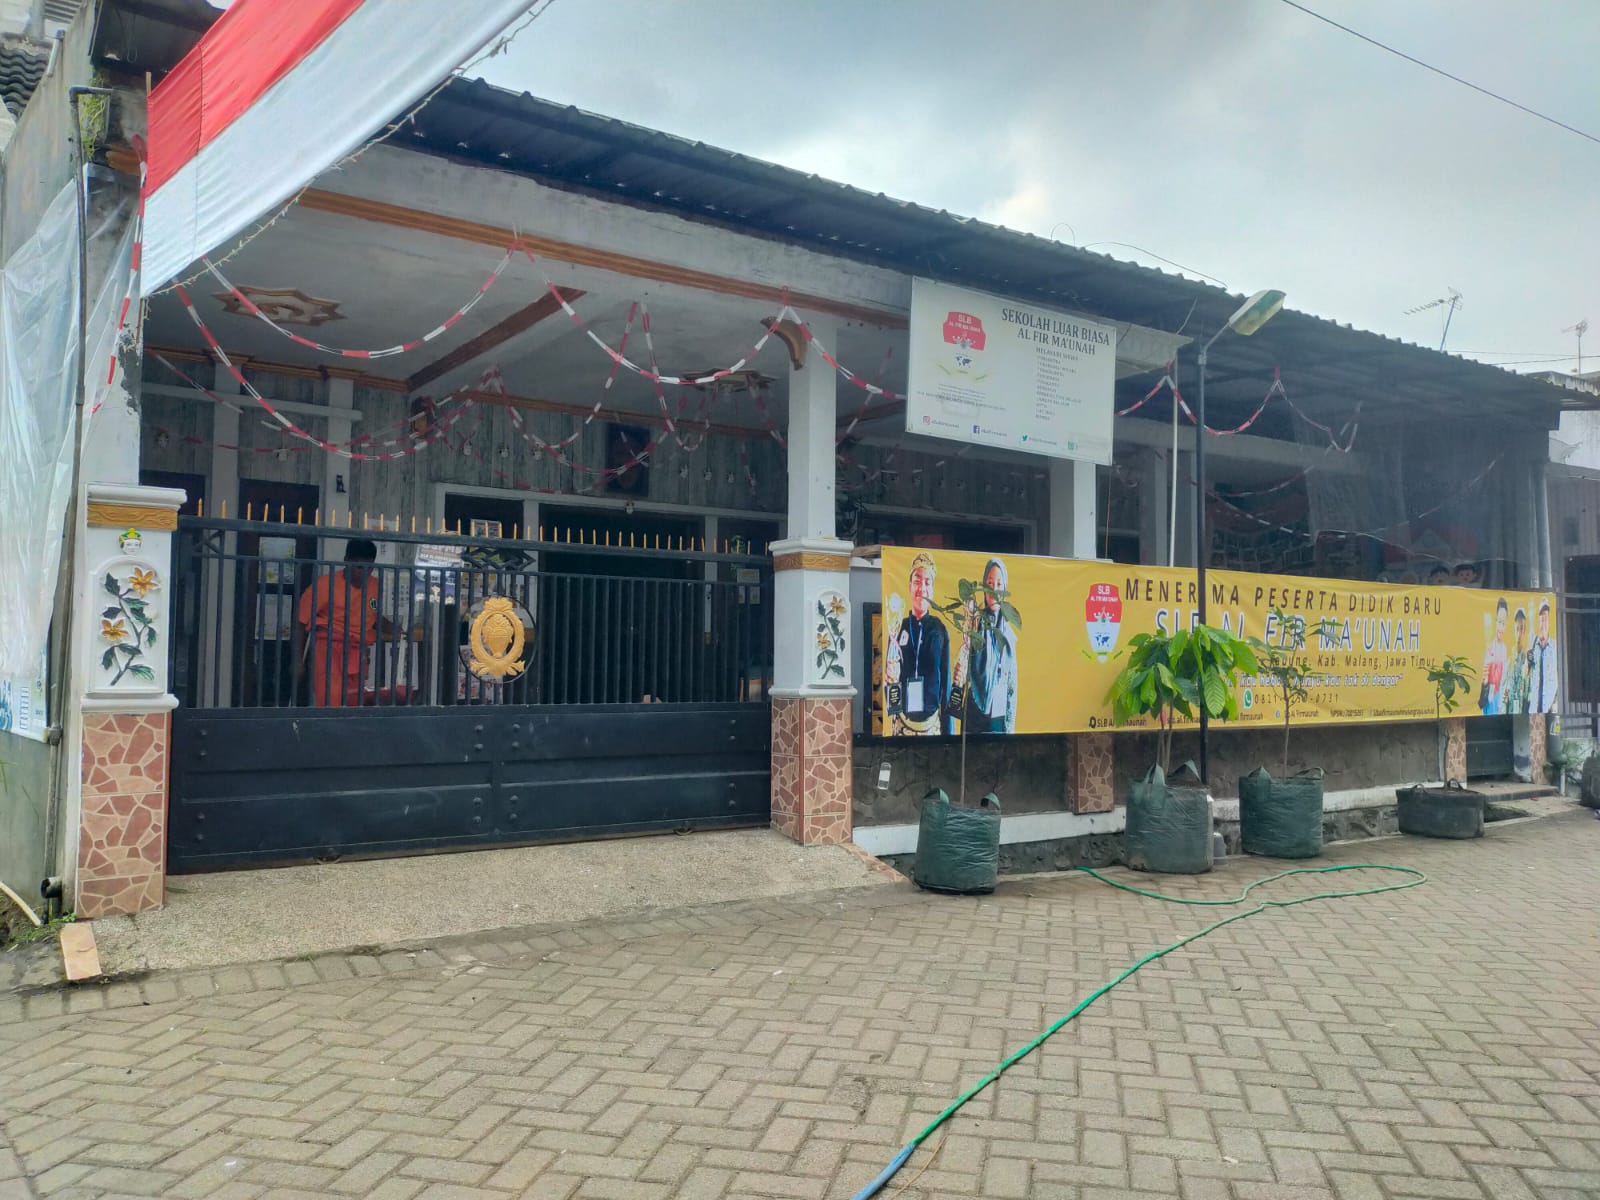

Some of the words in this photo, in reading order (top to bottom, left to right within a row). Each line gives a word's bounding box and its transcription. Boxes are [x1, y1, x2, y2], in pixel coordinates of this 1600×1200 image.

[1002, 308, 1050, 332] SEKOLAH
[1053, 320, 1079, 339] LUAR
[1081, 327, 1110, 346] BIASA
[1018, 327, 1031, 340] AL
[1033, 331, 1049, 345] FIR
[1052, 335, 1096, 355] MA'UNAH
[1098, 585, 1110, 595] SLB
[1126, 578, 1239, 606] MENERMA
[1255, 587, 1338, 611] PESERTA
[1350, 594, 1394, 613] DIDIK
[1404, 597, 1441, 615] BARU
[1319, 616, 1421, 653] MA'UNAH
[1345, 656, 1382, 670] Malang,
[1385, 656, 1406, 671] Jawa
[1411, 656, 1435, 668] Timur
